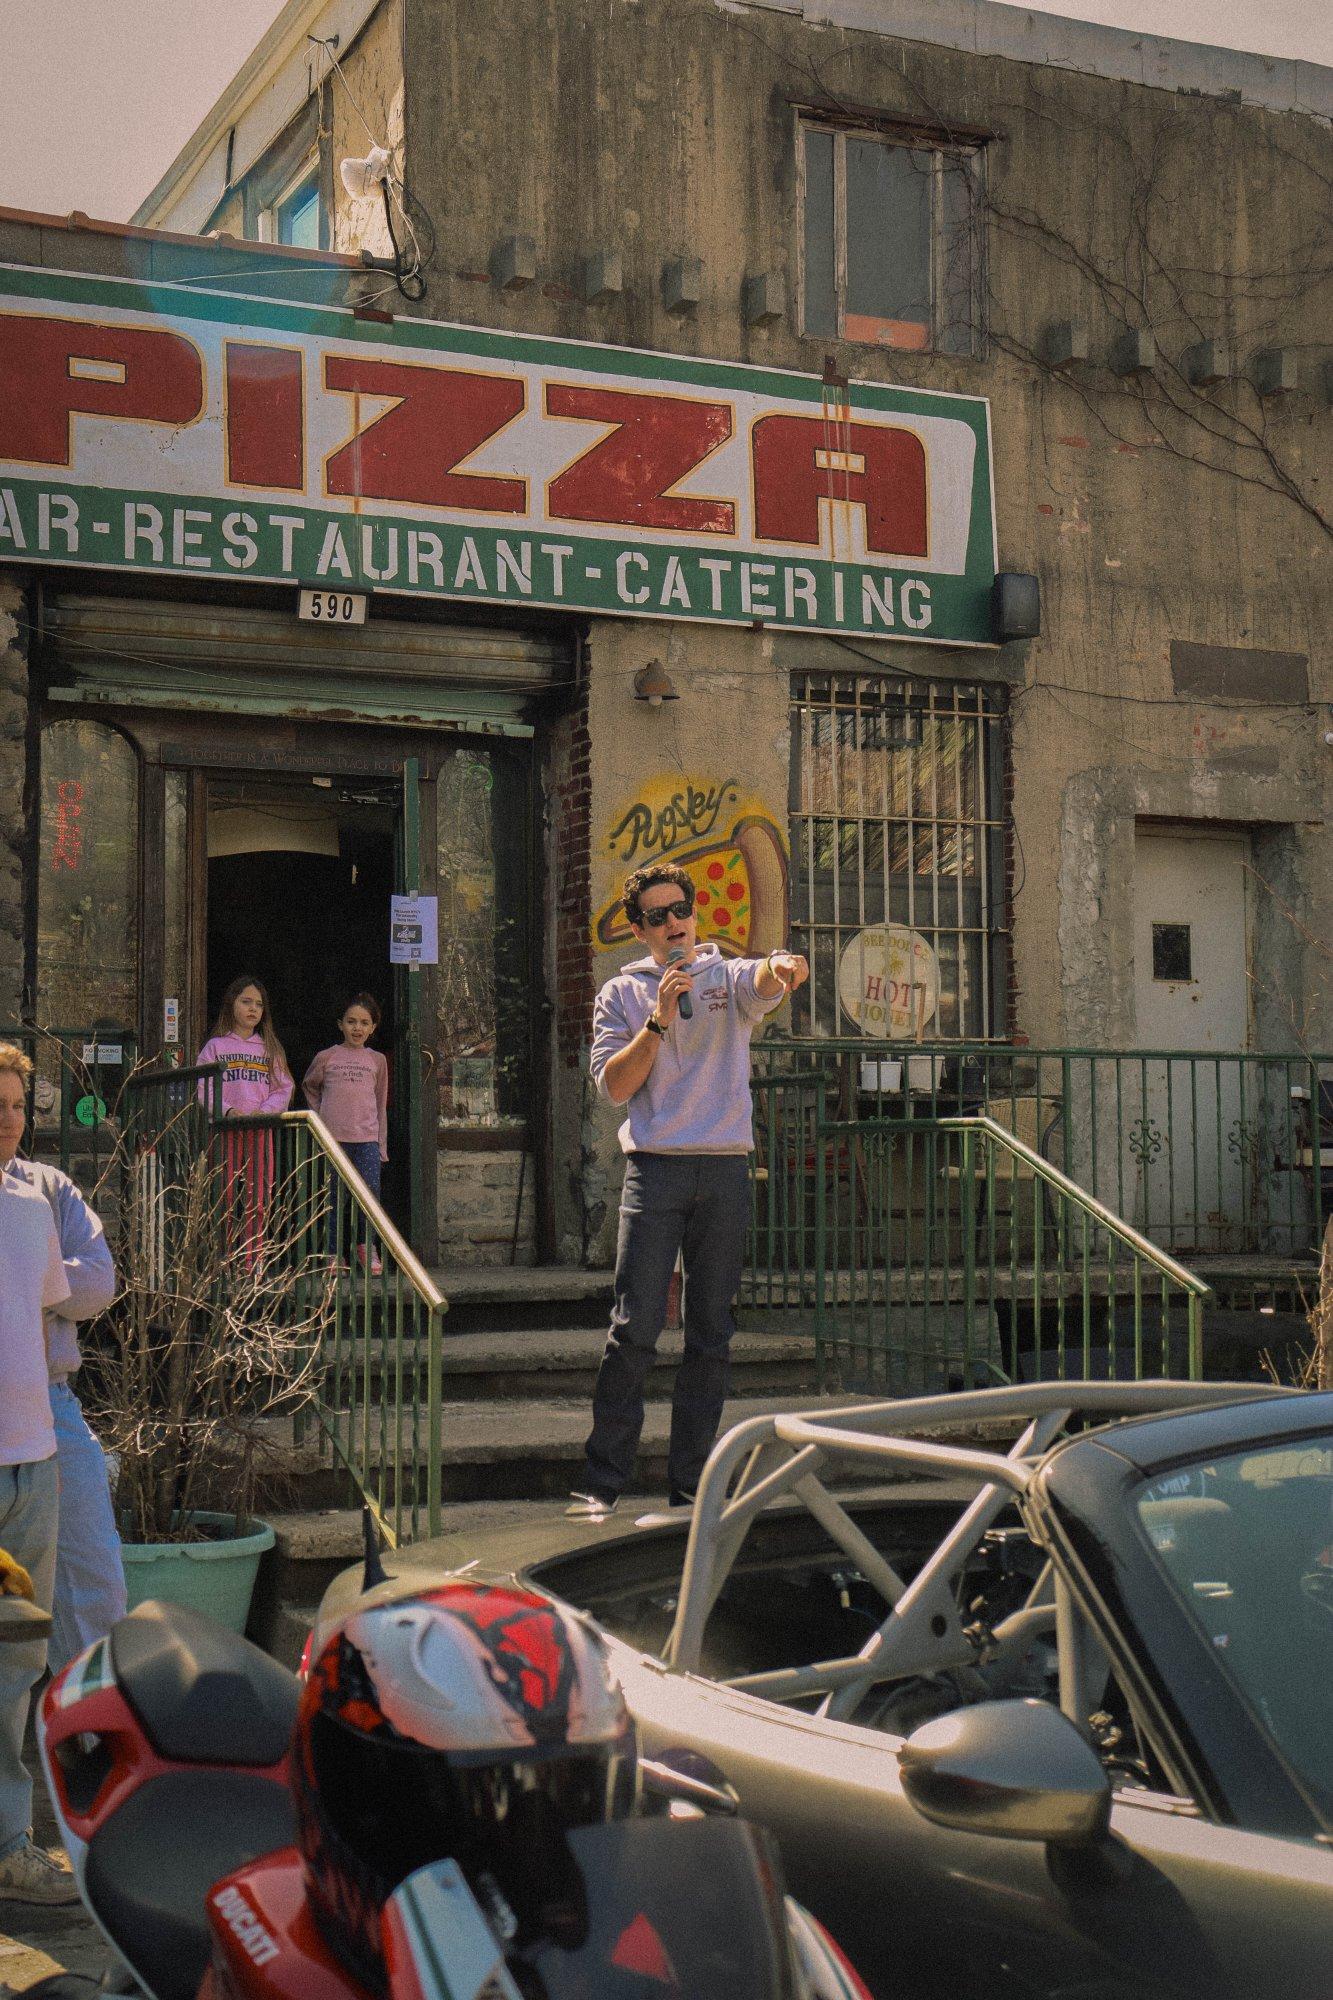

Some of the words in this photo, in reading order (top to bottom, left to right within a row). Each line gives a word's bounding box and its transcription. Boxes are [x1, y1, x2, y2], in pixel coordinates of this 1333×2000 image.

[0, 314, 931, 560] PIZZA
[311, 593, 353, 620] 590
[50, 781, 84, 872] OPEN
[865, 975, 912, 1008] HOT
[212, 1886, 280, 1966] DUCATI
